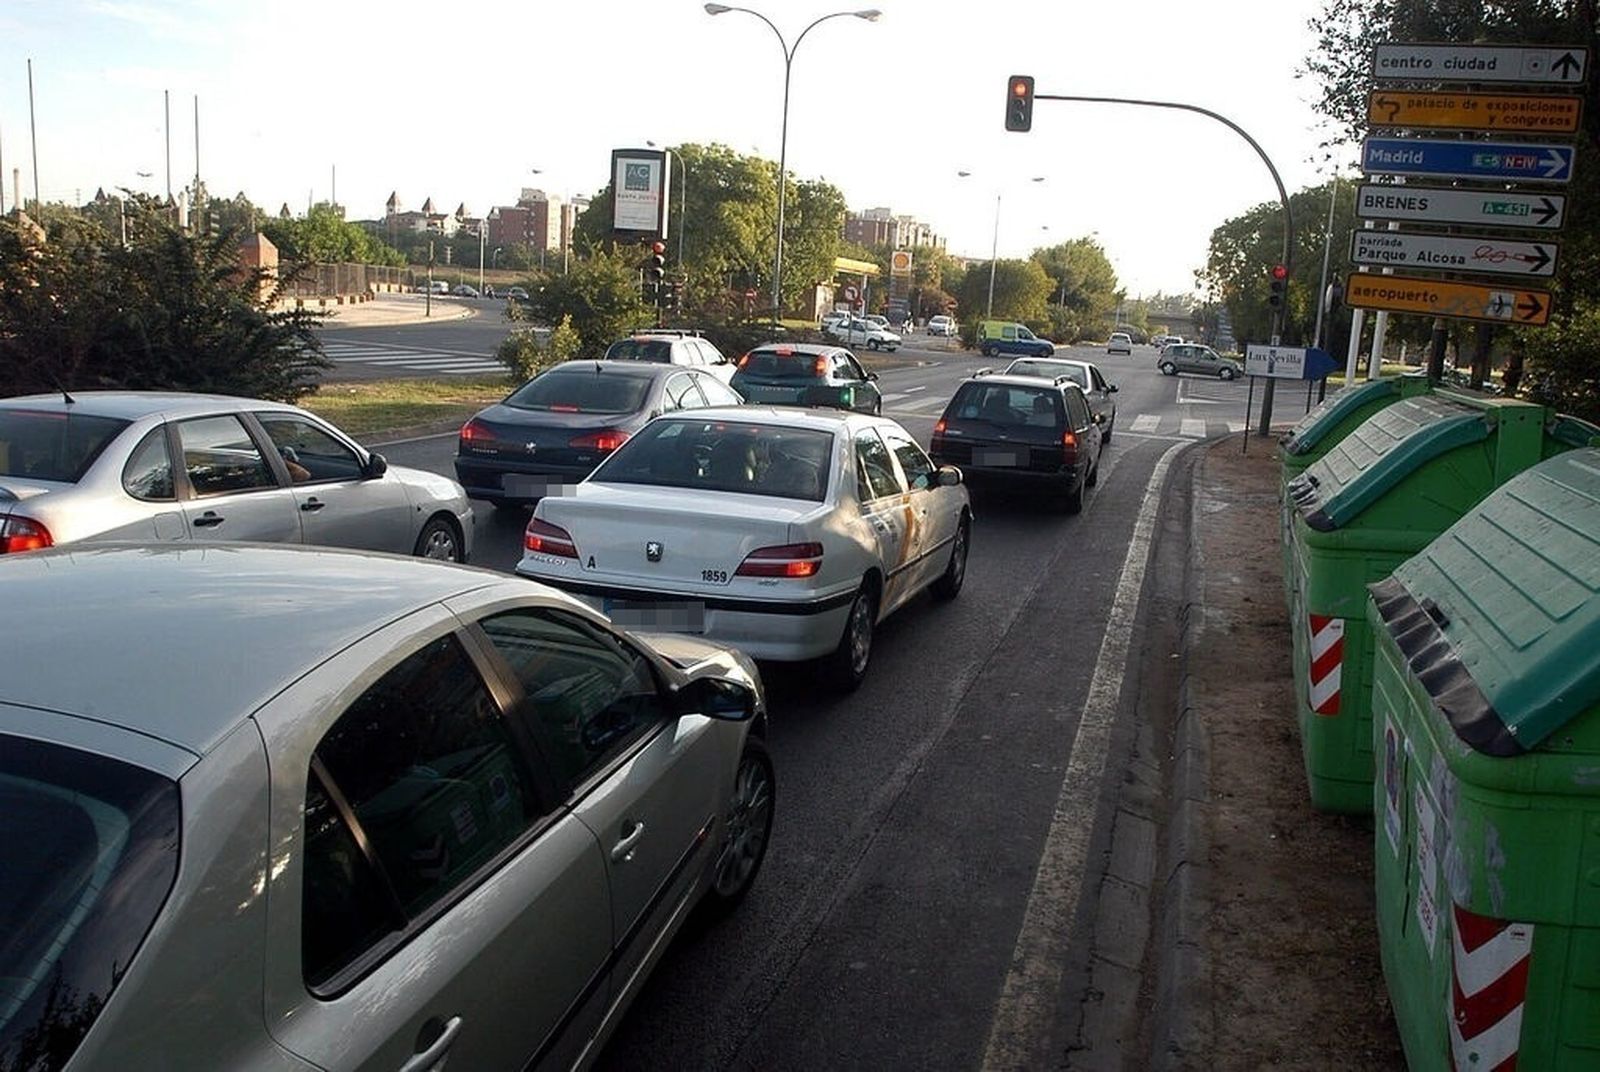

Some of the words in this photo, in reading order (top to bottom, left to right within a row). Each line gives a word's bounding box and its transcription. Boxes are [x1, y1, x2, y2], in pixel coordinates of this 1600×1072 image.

[1381, 56, 1432, 69] centro
[1443, 56, 1497, 70] ciudad
[1407, 98, 1455, 111] palacio
[1462, 99, 1478, 111] de
[1487, 101, 1573, 114] exposiciones
[1488, 115, 1496, 125] y
[1503, 114, 1571, 126] congresos
[1369, 150, 1424, 165] Madrid
[1364, 195, 1429, 211] BRENES
[1360, 237, 1402, 248] barriada
[1358, 246, 1406, 262] Parque
[1416, 250, 1466, 265] Alcosa
[1353, 287, 1438, 303] aeropuerto
[587, 555, 596, 569] A
[701, 569, 727, 582] 1859
